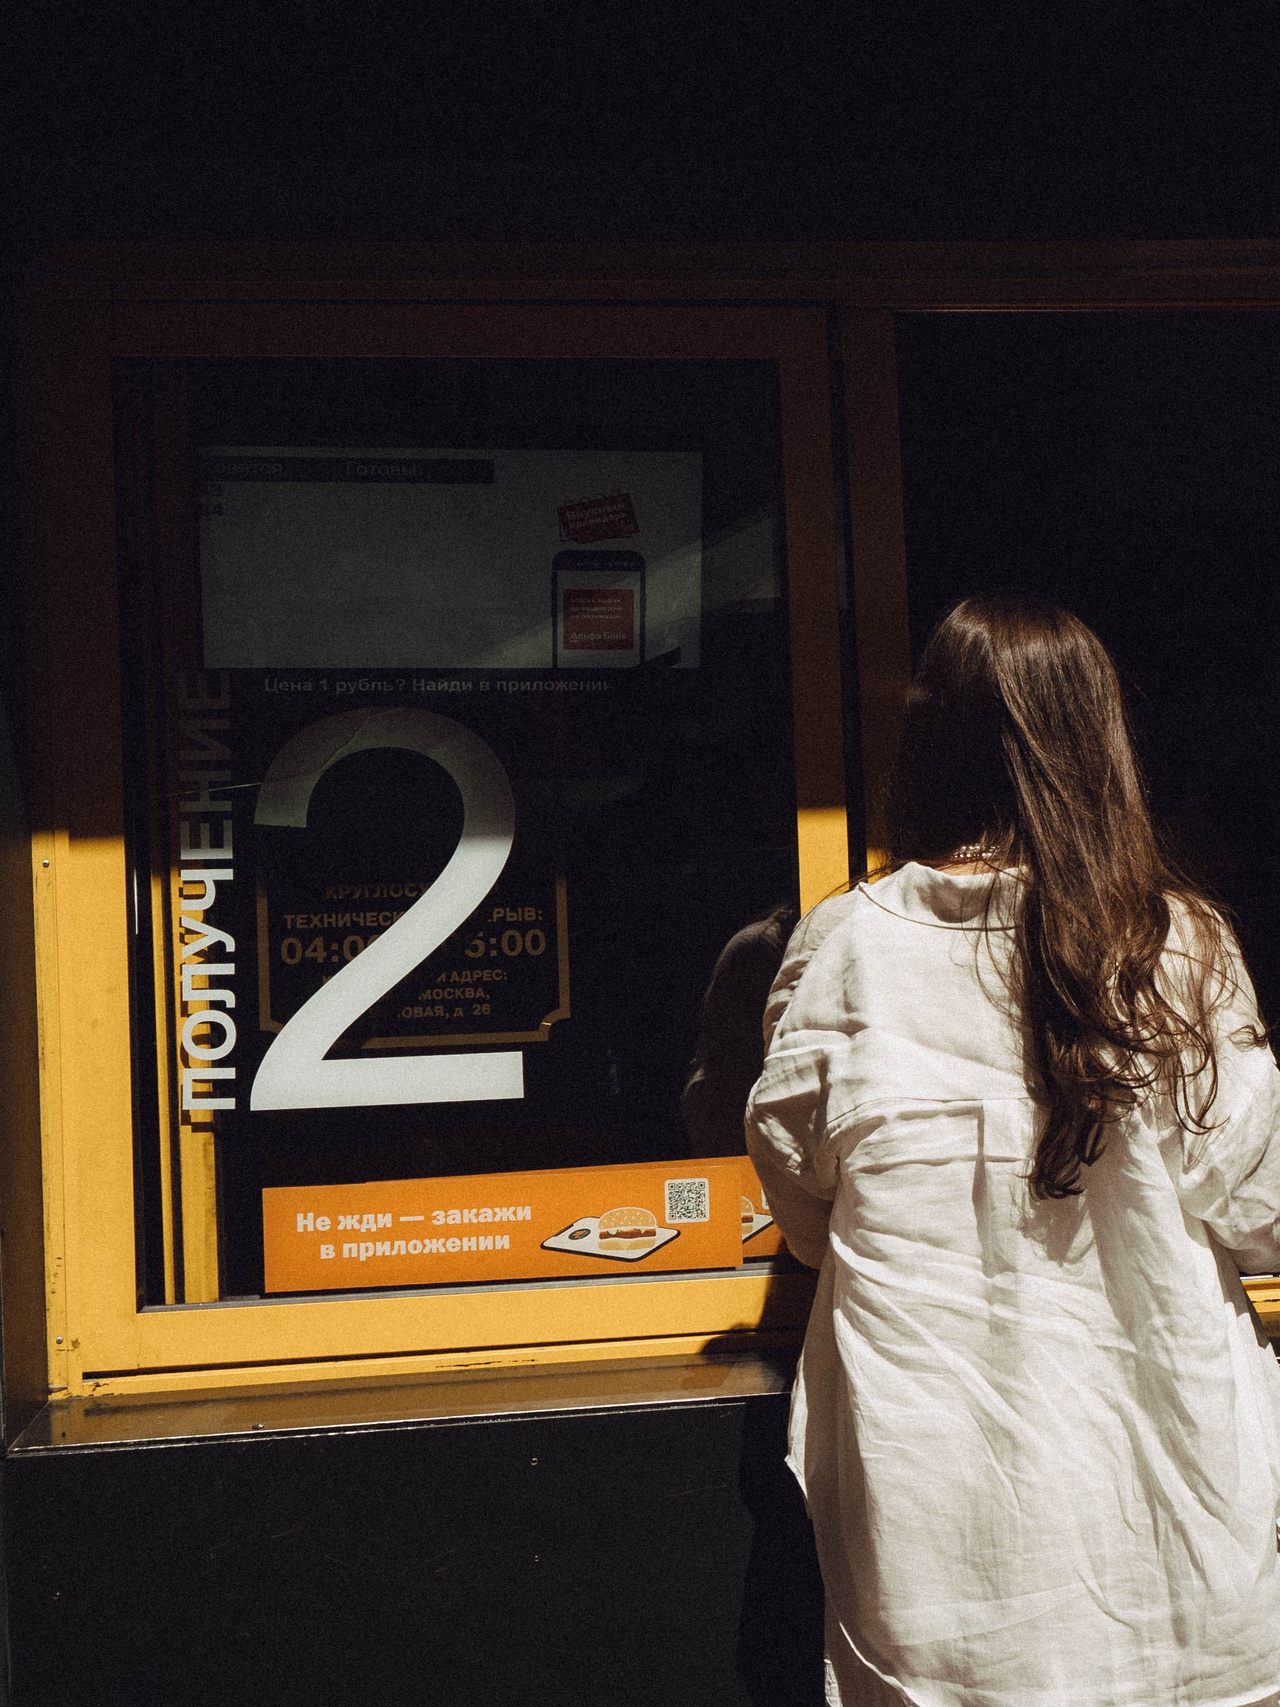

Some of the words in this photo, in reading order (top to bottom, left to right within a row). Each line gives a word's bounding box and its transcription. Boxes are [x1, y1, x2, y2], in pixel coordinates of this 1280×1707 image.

[264, 678, 313, 694] Цена
[319, 678, 328, 691] 1
[336, 678, 405, 696] рубль?
[412, 677, 472, 693] Найди
[479, 681, 490, 691] в
[180, 671, 237, 1111] ПОЛУЧЕНИЕ
[250, 707, 525, 1112] 2
[284, 910, 408, 930] ТЕХНИЧЕСК
[464, 928, 547, 960] 5:00
[449, 969, 508, 984] АДРЕС:
[472, 1003, 491, 1017] 26
[296, 1212, 331, 1233] Не
[337, 1212, 392, 1233] жди
[431, 1205, 532, 1226] закажи
[319, 1243, 336, 1260] в
[342, 1234, 511, 1262] приложении
